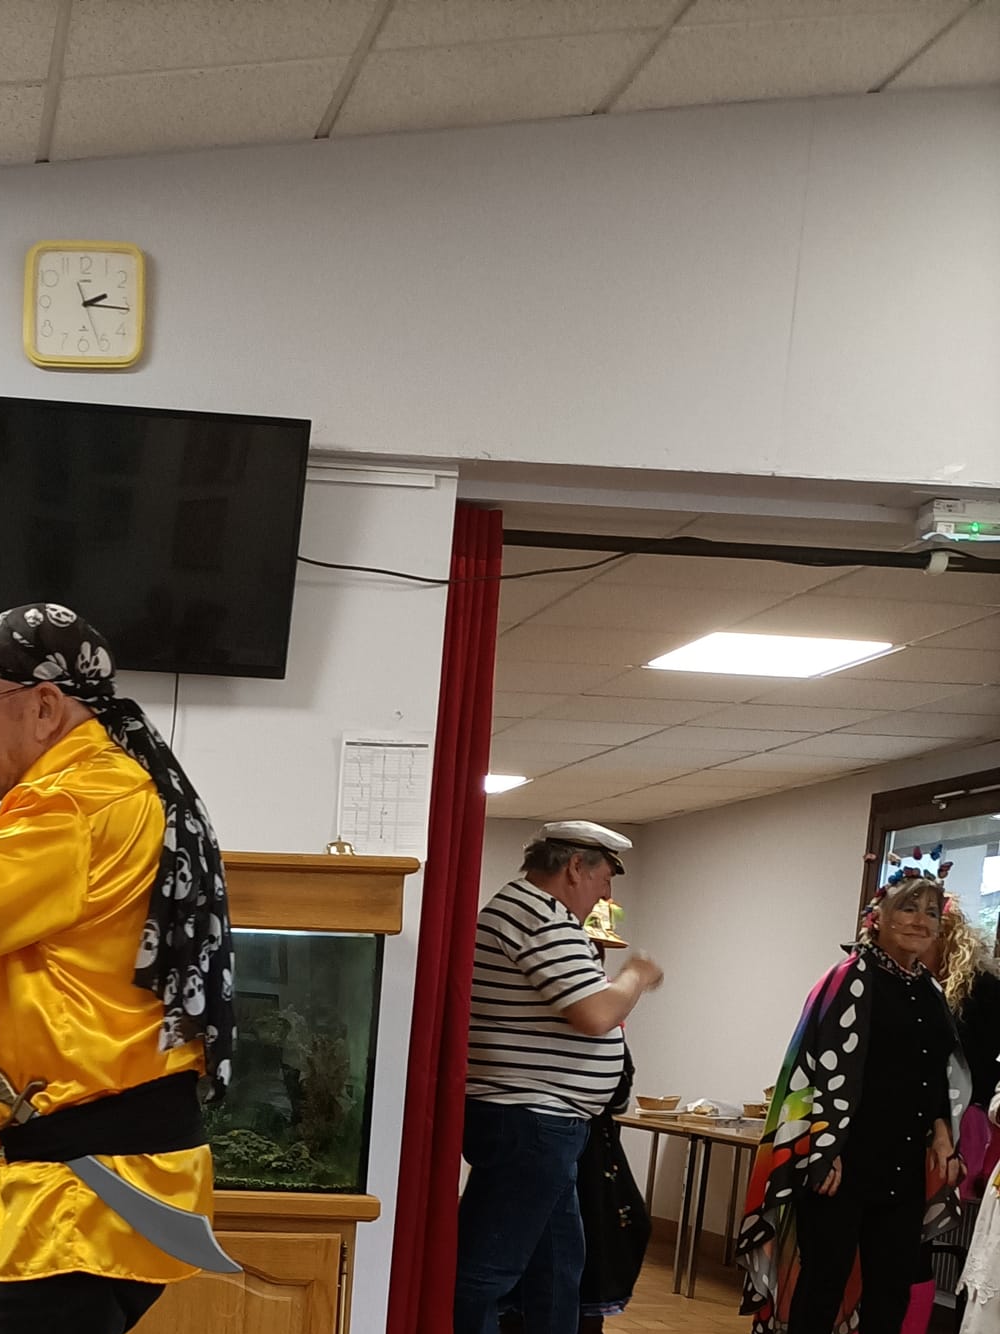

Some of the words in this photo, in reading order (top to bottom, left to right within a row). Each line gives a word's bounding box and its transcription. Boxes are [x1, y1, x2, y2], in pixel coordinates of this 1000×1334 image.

[117, 270, 128, 289] 2
[40, 319, 54, 338] 8
[115, 321, 127, 339] 4
[77, 335, 90, 353] 6
